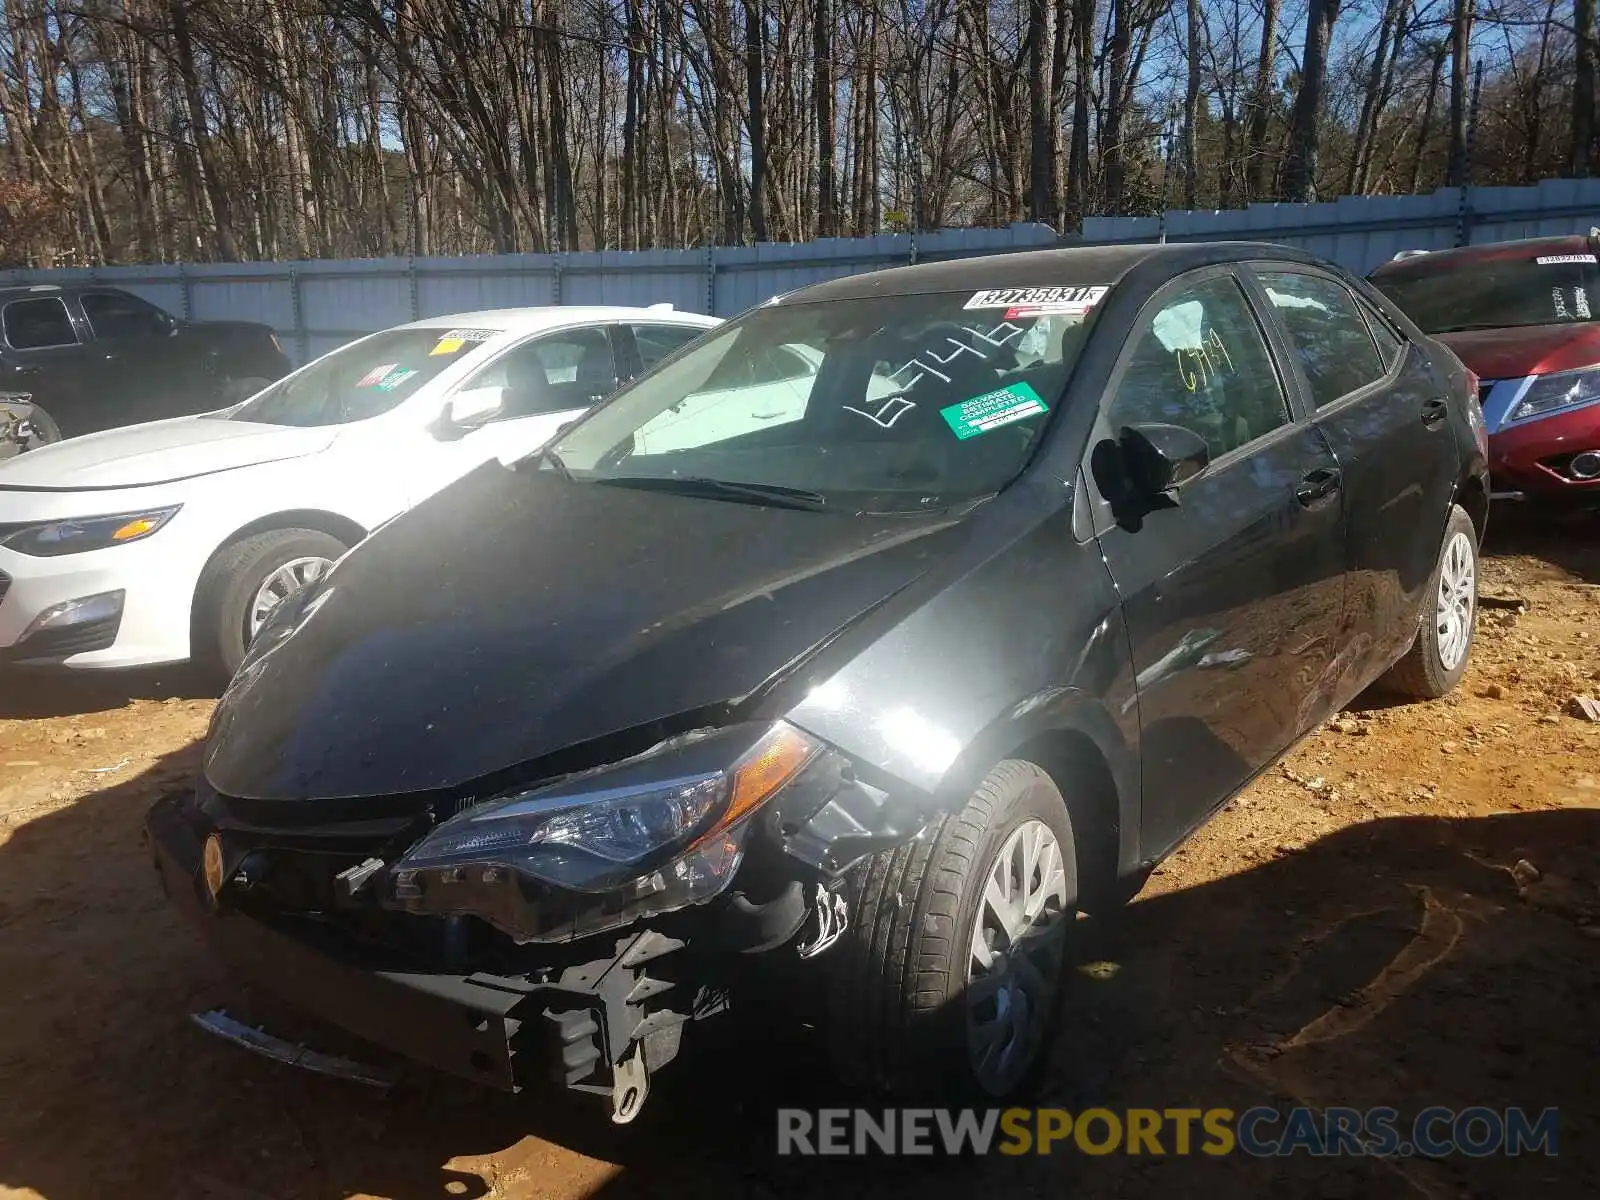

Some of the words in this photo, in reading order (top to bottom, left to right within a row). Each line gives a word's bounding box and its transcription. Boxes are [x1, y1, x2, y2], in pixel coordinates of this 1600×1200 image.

[982, 286, 1083, 305] 32735931
[959, 396, 1025, 421] COMPLETED
[960, 388, 1010, 409] SALVAGE
[962, 394, 1016, 414] ESTIMATE
